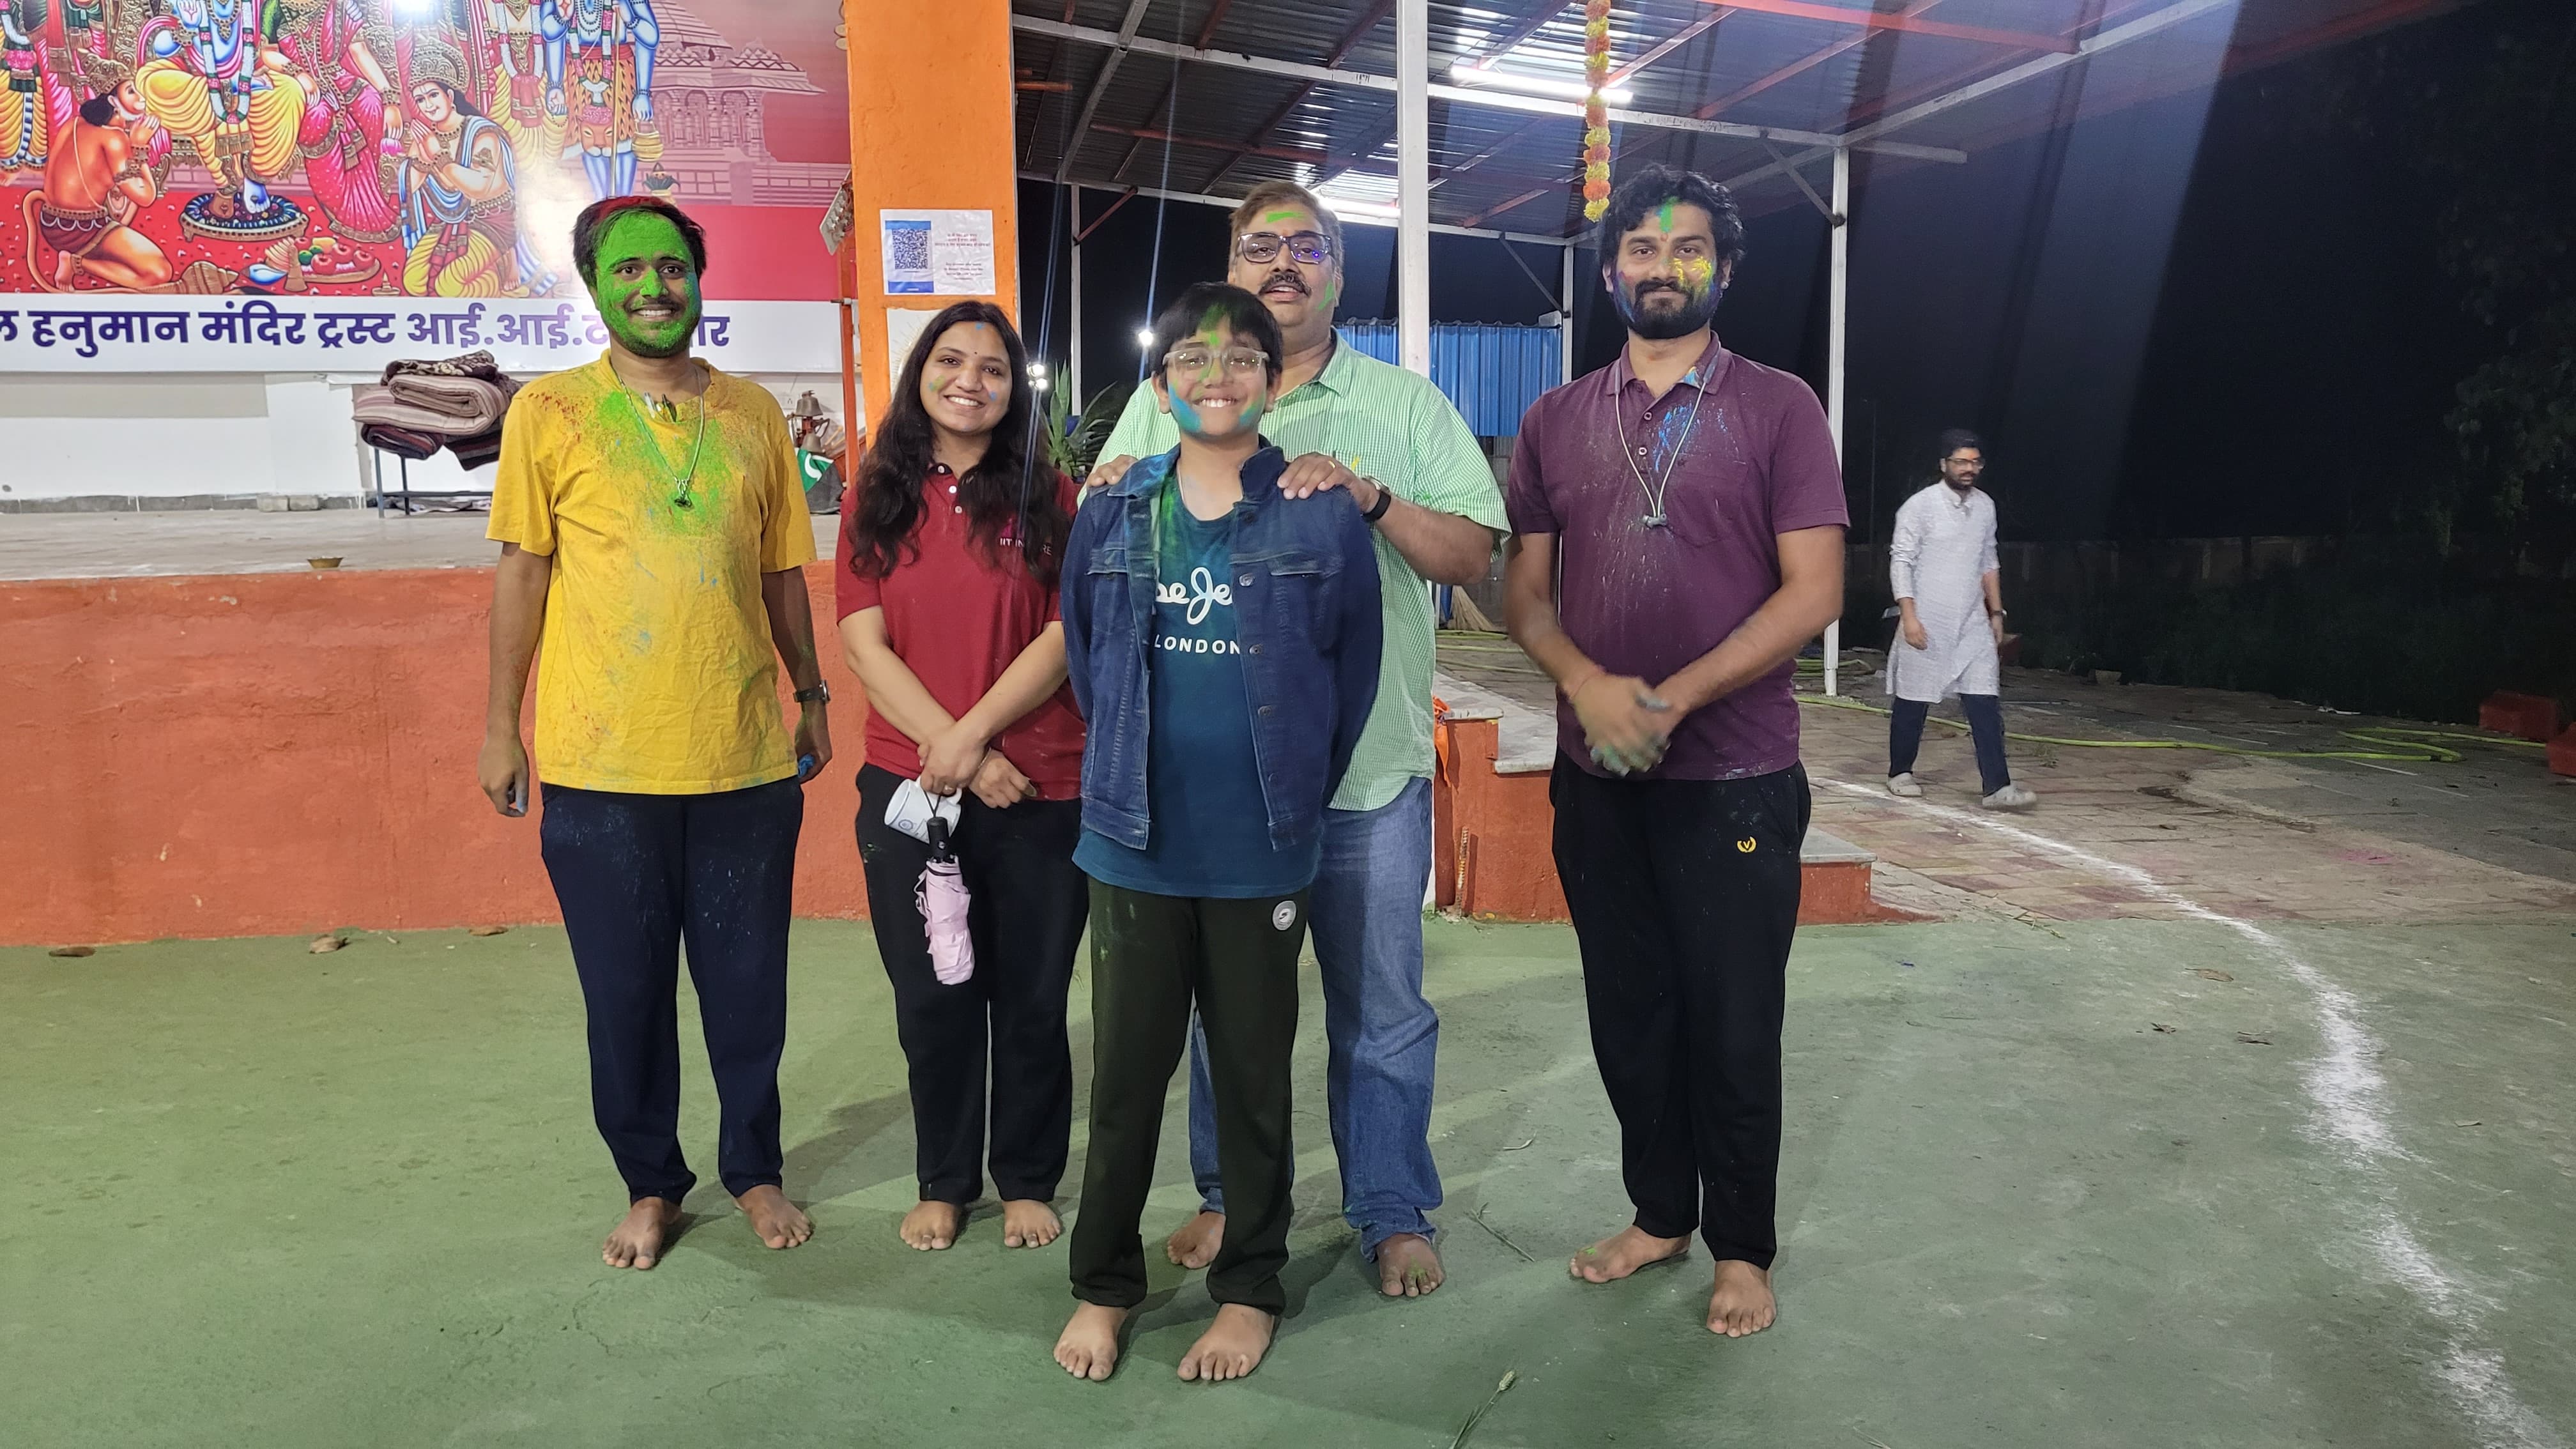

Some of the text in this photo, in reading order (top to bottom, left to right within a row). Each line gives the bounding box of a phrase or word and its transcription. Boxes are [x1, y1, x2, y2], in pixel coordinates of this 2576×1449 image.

[27, 310, 190, 357] हनुमान
[198, 300, 306, 346] मंदिर
[314, 313, 396, 348] ट्रस्ट
[1000, 537, 1013, 546] IIT
[1154, 634, 1240, 655] LONDON
